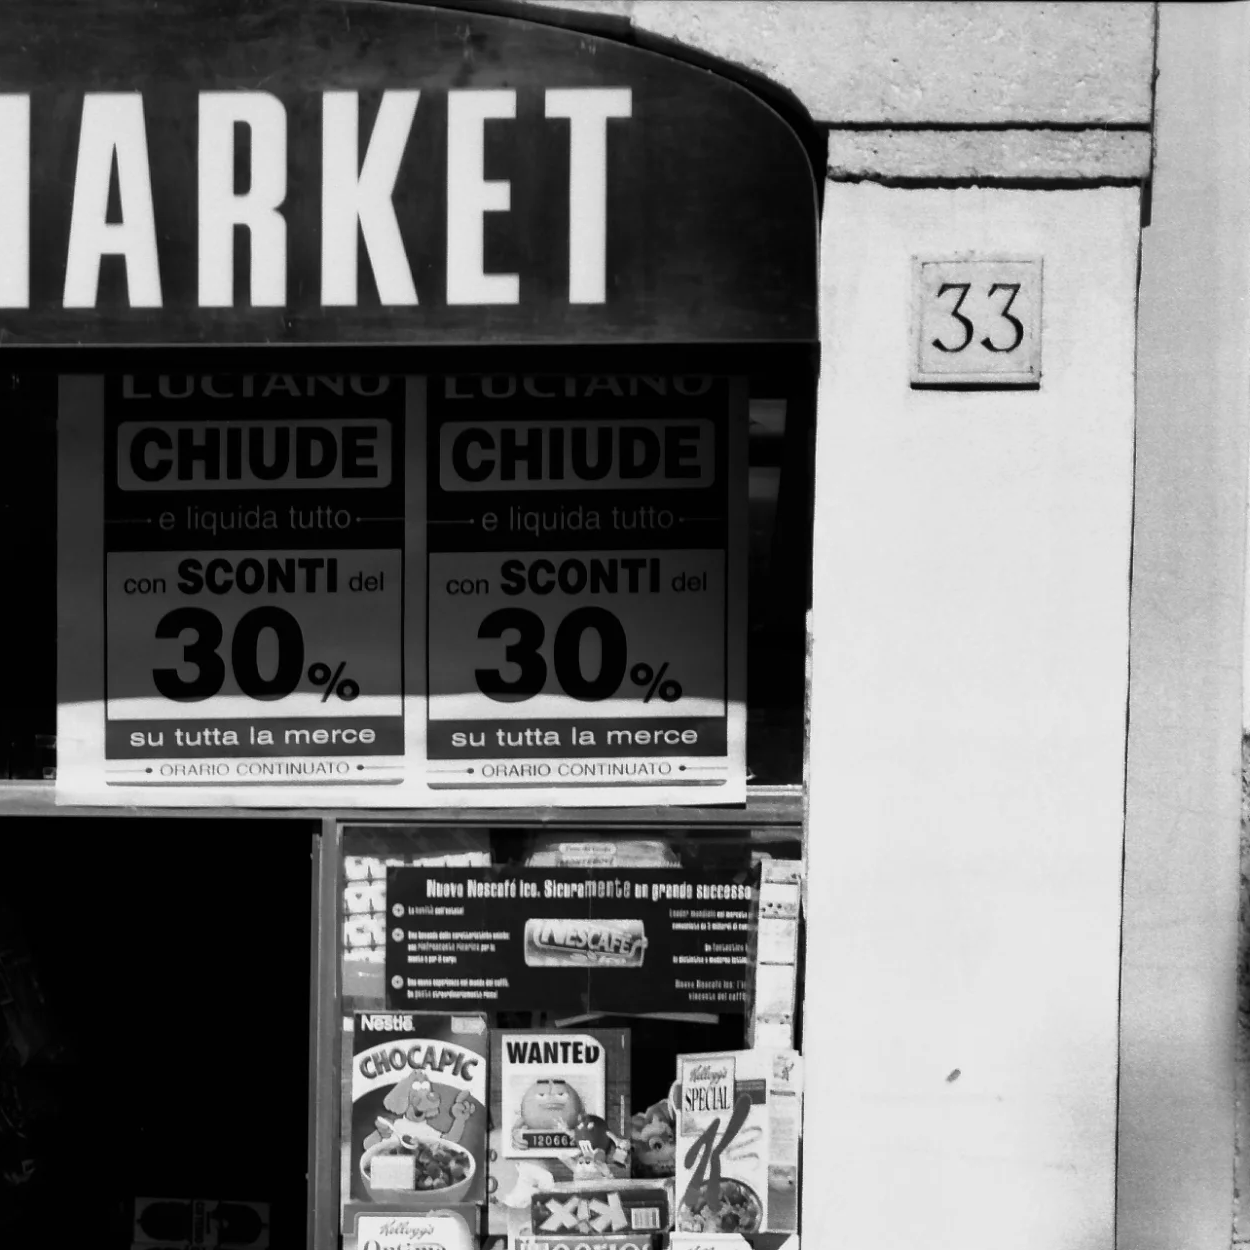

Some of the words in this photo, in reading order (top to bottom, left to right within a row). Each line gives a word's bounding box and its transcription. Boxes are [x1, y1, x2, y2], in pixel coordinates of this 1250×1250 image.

[932, 283, 1024, 353] 33
[130, 426, 378, 482] CHIUDE
[452, 426, 700, 482] CHIUDE
[158, 510, 176, 530] e
[186, 505, 278, 536] liquida
[289, 506, 351, 530] tutto
[481, 511, 498, 531] e
[510, 504, 601, 537] liquida
[611, 506, 674, 530] tutto
[124, 578, 166, 594] con
[177, 558, 337, 594] SCONTI
[348, 571, 384, 592] del
[446, 578, 489, 595] con
[501, 558, 660, 595] SCONTI
[671, 571, 707, 592] del
[130, 731, 164, 747] su
[174, 727, 239, 747] tutta
[250, 726, 274, 745] la
[284, 728, 376, 746] merce
[451, 731, 485, 747] su
[496, 728, 561, 747] tutta
[571, 727, 596, 746] la
[607, 728, 698, 746] merce
[160, 763, 230, 777] ORARIO
[236, 761, 350, 776] CONTINUATO
[482, 764, 550, 778] ORARIO
[558, 762, 672, 777] CONTINUATO
[426, 879, 464, 898] Nuovo
[652, 881, 693, 902] grande
[696, 884, 751, 899] successo
[359, 1044, 479, 1081] CHOCAPIC
[507, 1041, 600, 1064] WANTED
[685, 1086, 731, 1112] SPECIAL
